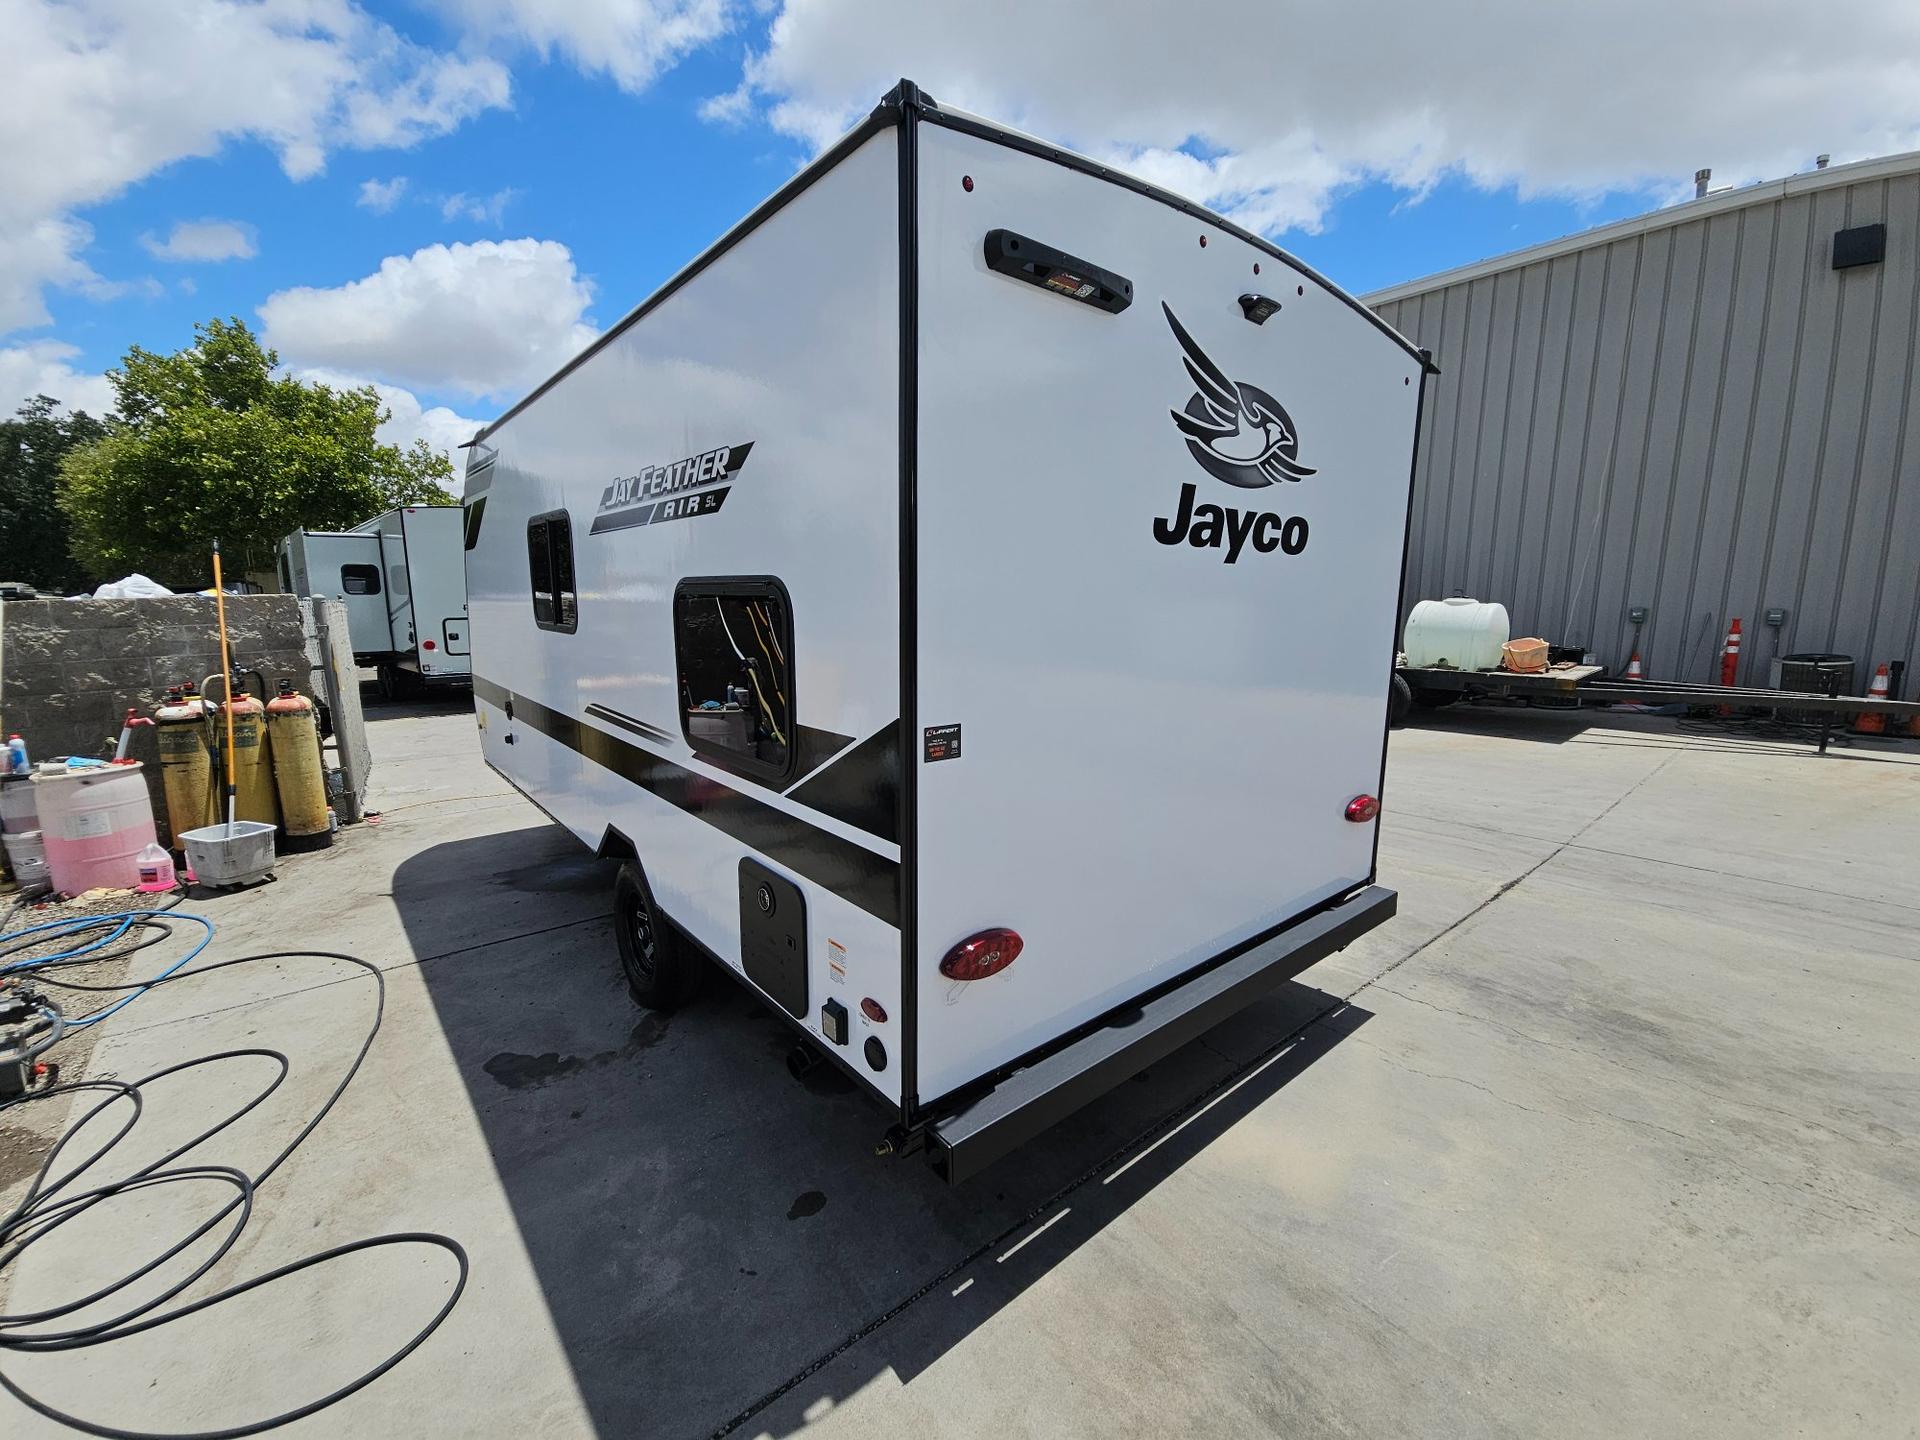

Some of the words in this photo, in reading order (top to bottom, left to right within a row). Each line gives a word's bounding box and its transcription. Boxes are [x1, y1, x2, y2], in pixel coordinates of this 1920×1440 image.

[605, 477, 637, 506] JAY
[637, 446, 731, 499] FEATHER
[663, 496, 701, 518] AIR
[705, 495, 717, 508] SL
[1153, 483, 1309, 564] Jayco
